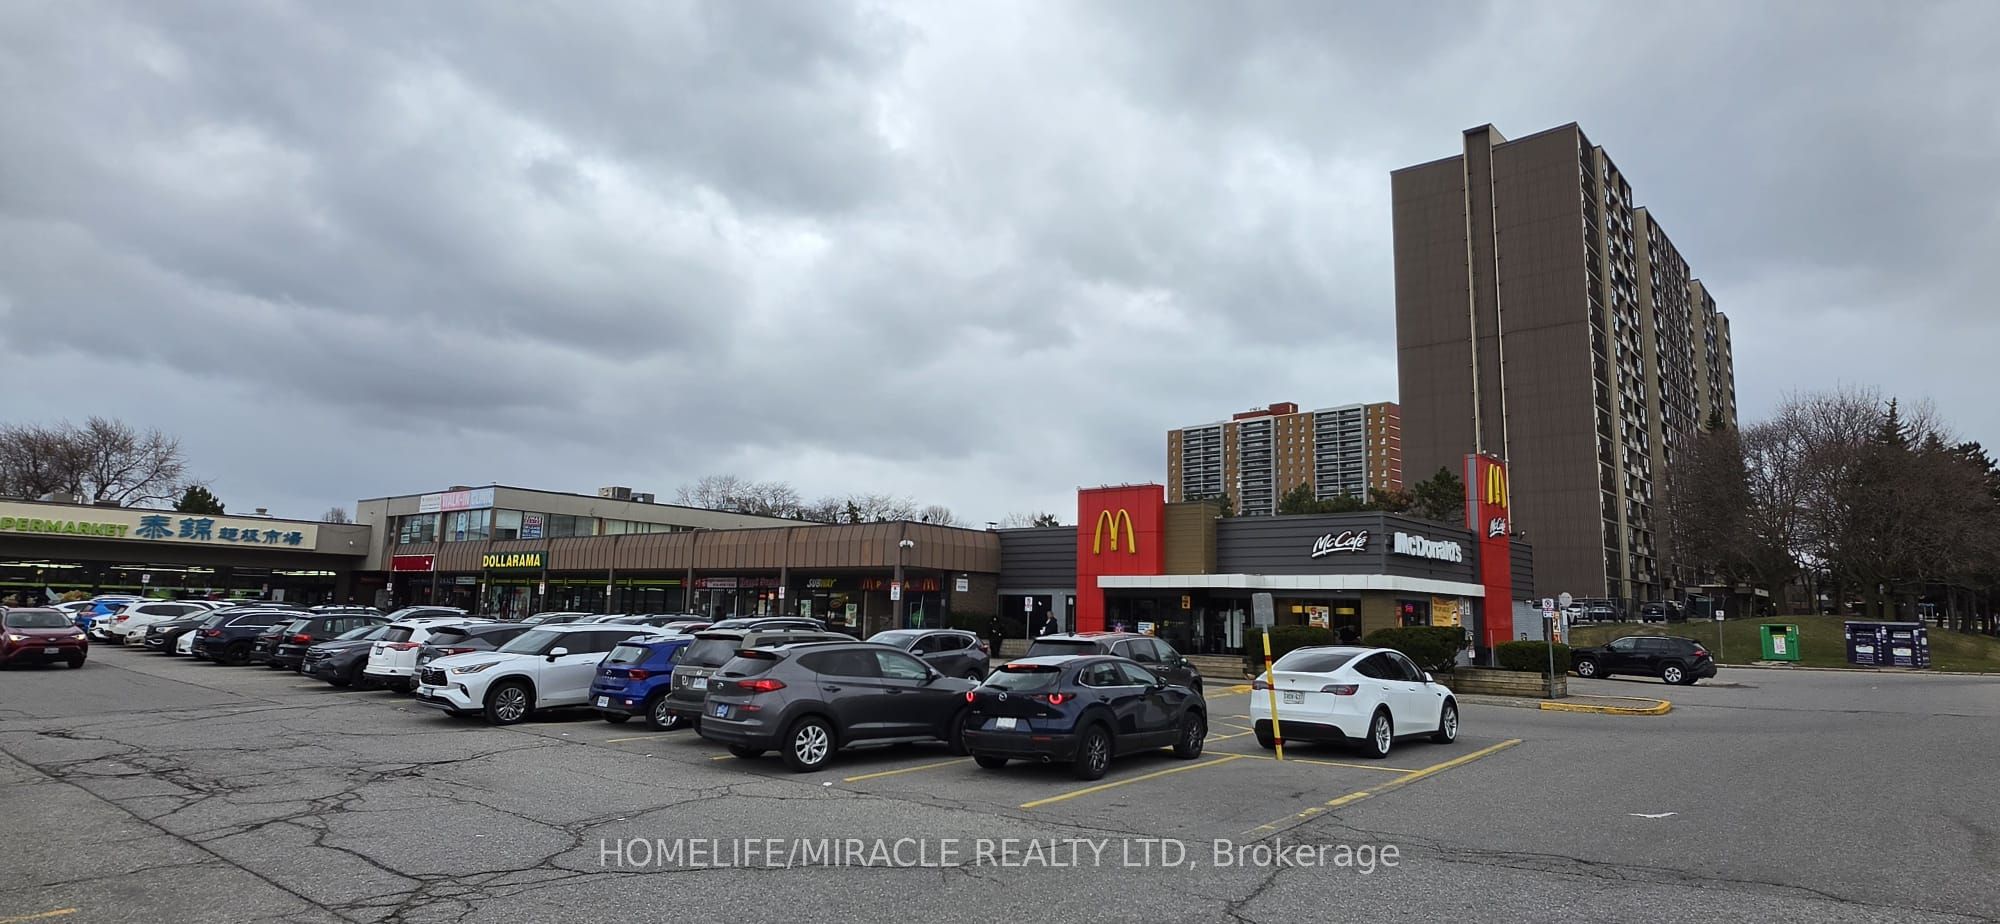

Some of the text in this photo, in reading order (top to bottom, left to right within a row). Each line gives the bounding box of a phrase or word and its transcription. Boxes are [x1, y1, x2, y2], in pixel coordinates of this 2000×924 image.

[1394, 532, 1463, 563] McDonald's
[483, 554, 540, 568] DOLLARAMA
[806, 578, 837, 589] SUBWAY
